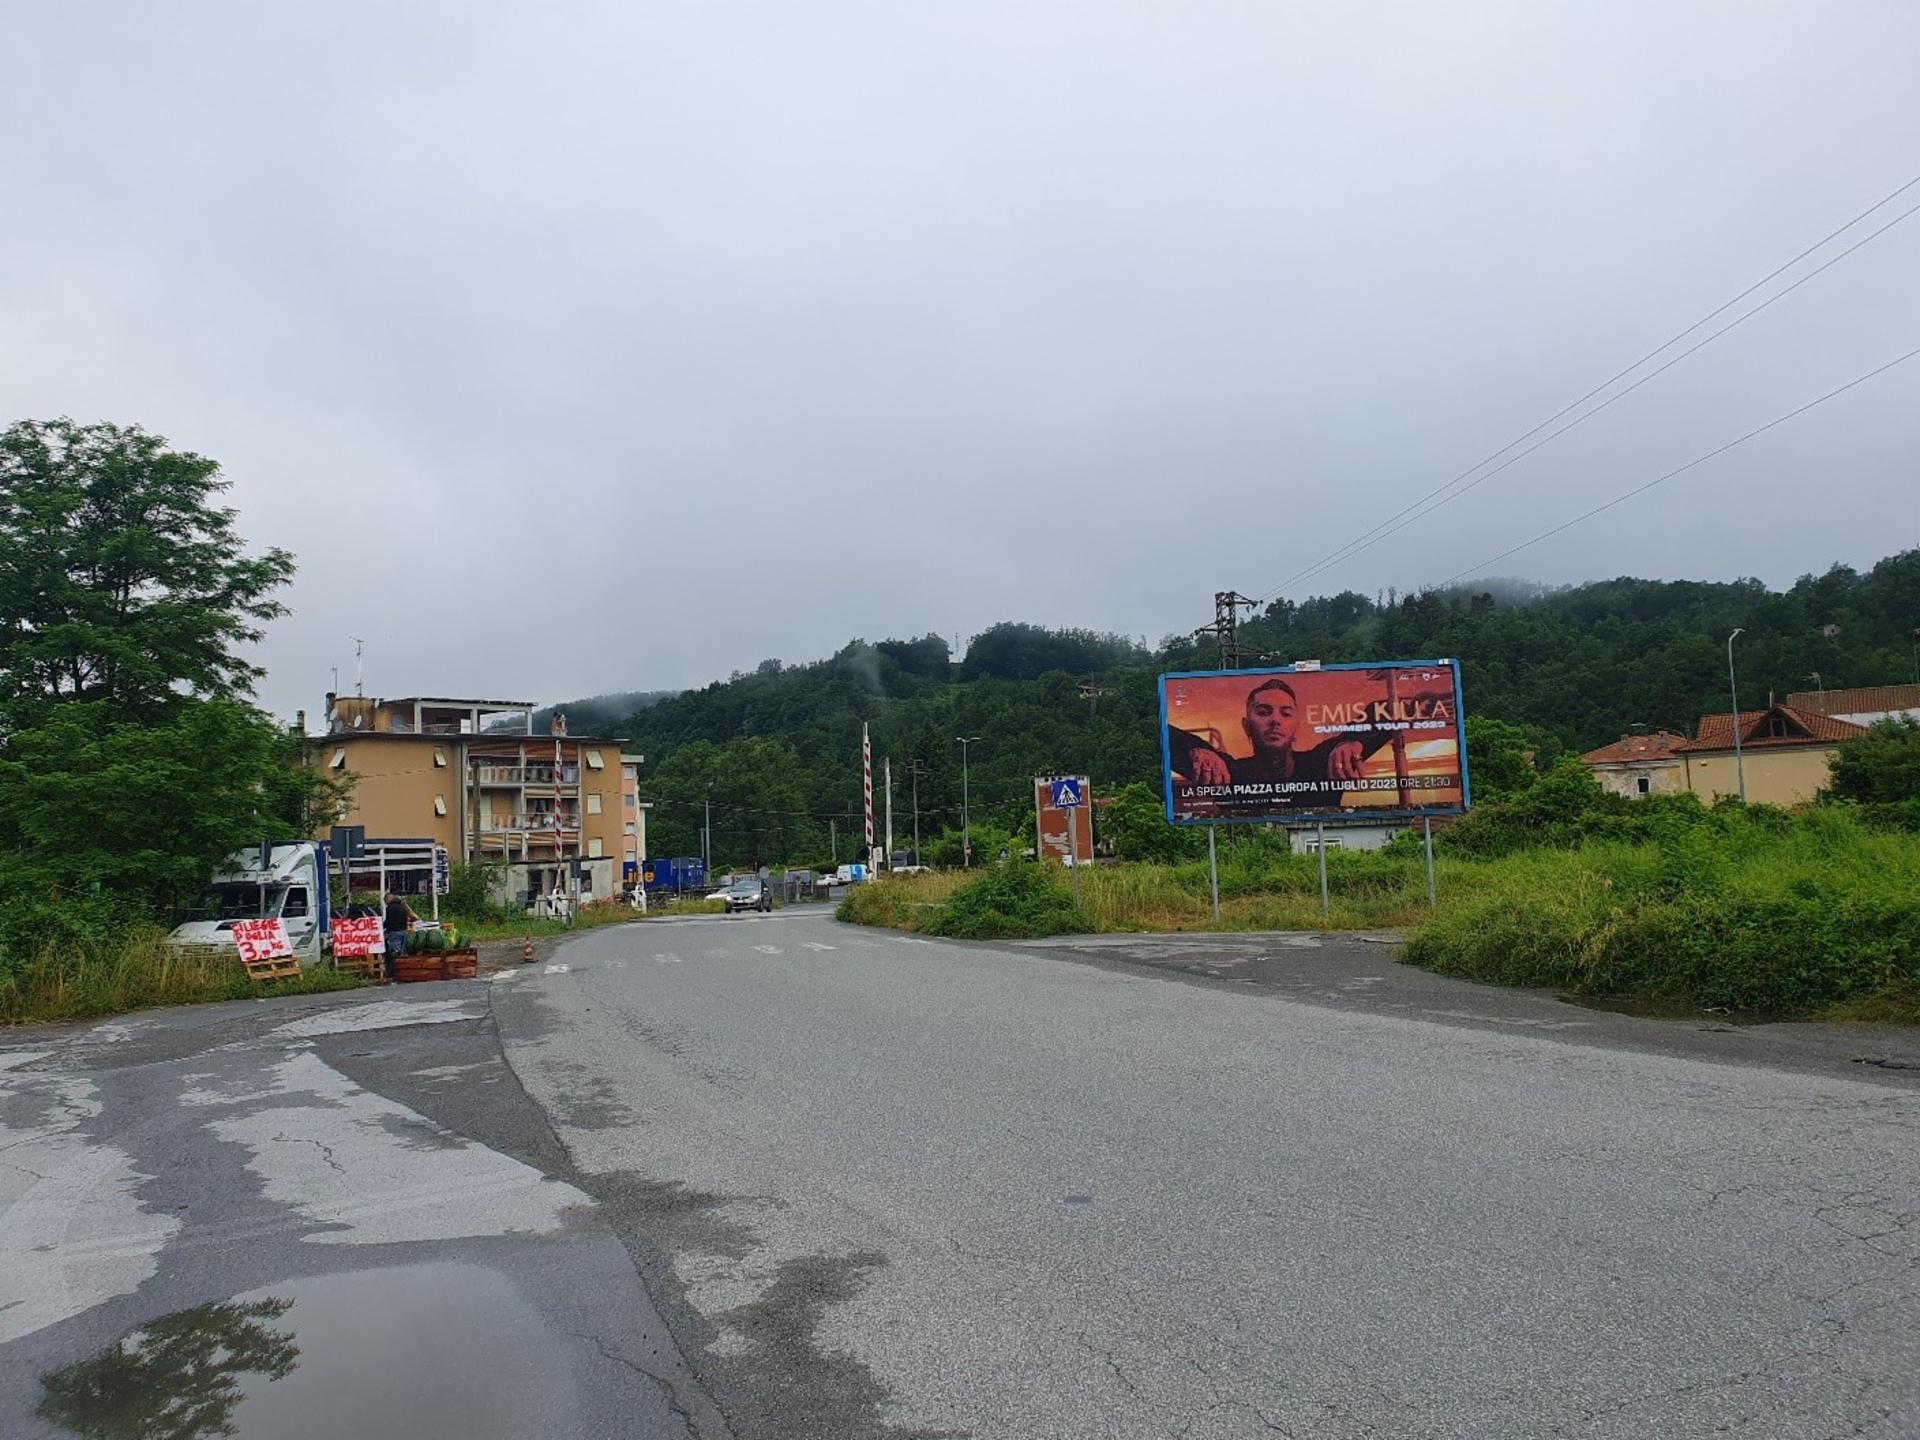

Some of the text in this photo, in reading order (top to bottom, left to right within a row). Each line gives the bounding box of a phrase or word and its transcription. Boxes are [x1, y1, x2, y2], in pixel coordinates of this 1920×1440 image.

[1306, 700, 1449, 724] EMIS KILLA
[1314, 723, 1372, 733] SUMMER
[1376, 721, 1410, 731] TOUR
[1181, 787, 1194, 797] LA
[1196, 785, 1232, 797] SPEZIA
[1234, 783, 1273, 795] PIAZZA
[1275, 781, 1318, 793] EUROPA
[1319, 781, 1329, 791] 11
[1331, 779, 1368, 791] LUGLIO
[1370, 778, 1397, 789] 2023
[1400, 778, 1420, 788] ORE
[332, 918, 377, 932] PESCHE
